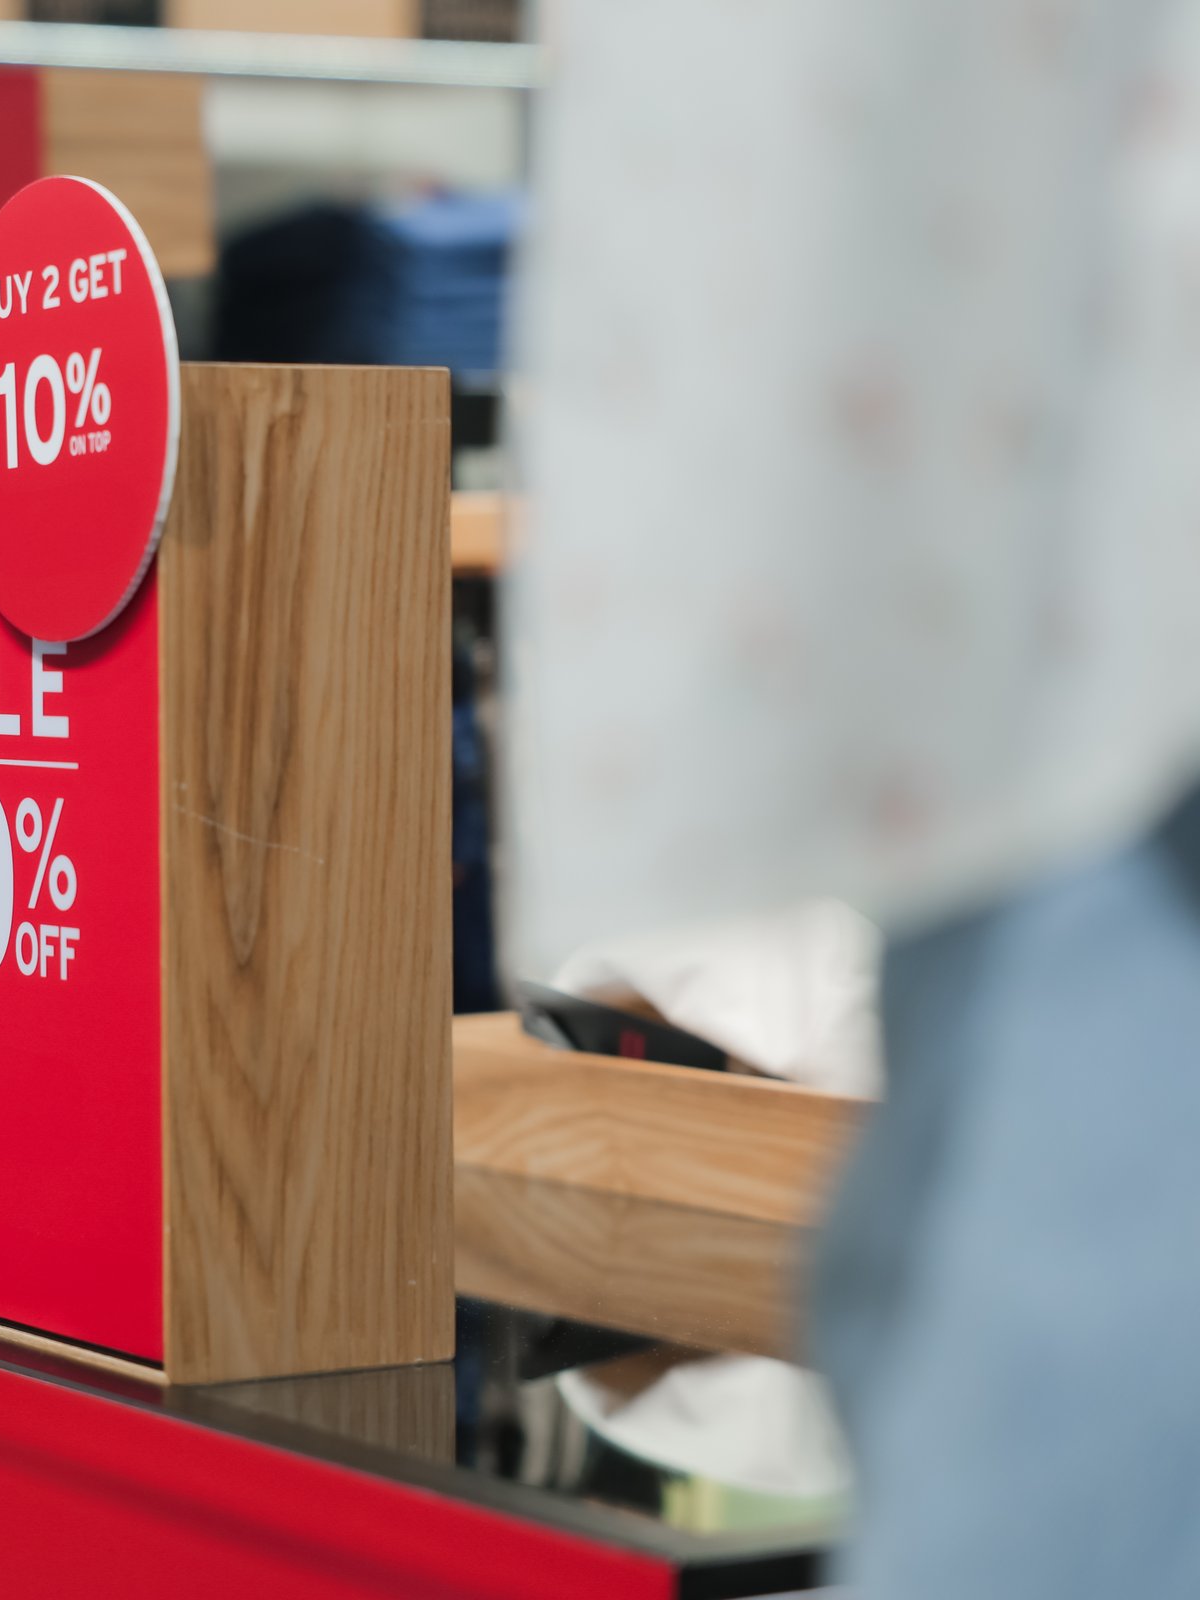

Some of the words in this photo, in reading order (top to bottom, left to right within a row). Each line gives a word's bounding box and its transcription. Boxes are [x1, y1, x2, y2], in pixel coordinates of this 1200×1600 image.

[41, 264, 61, 310] 2
[68, 248, 127, 303] GET
[69, 434, 87, 456] ON
[87, 429, 112, 453] TOP
[15, 921, 81, 981] OFF
